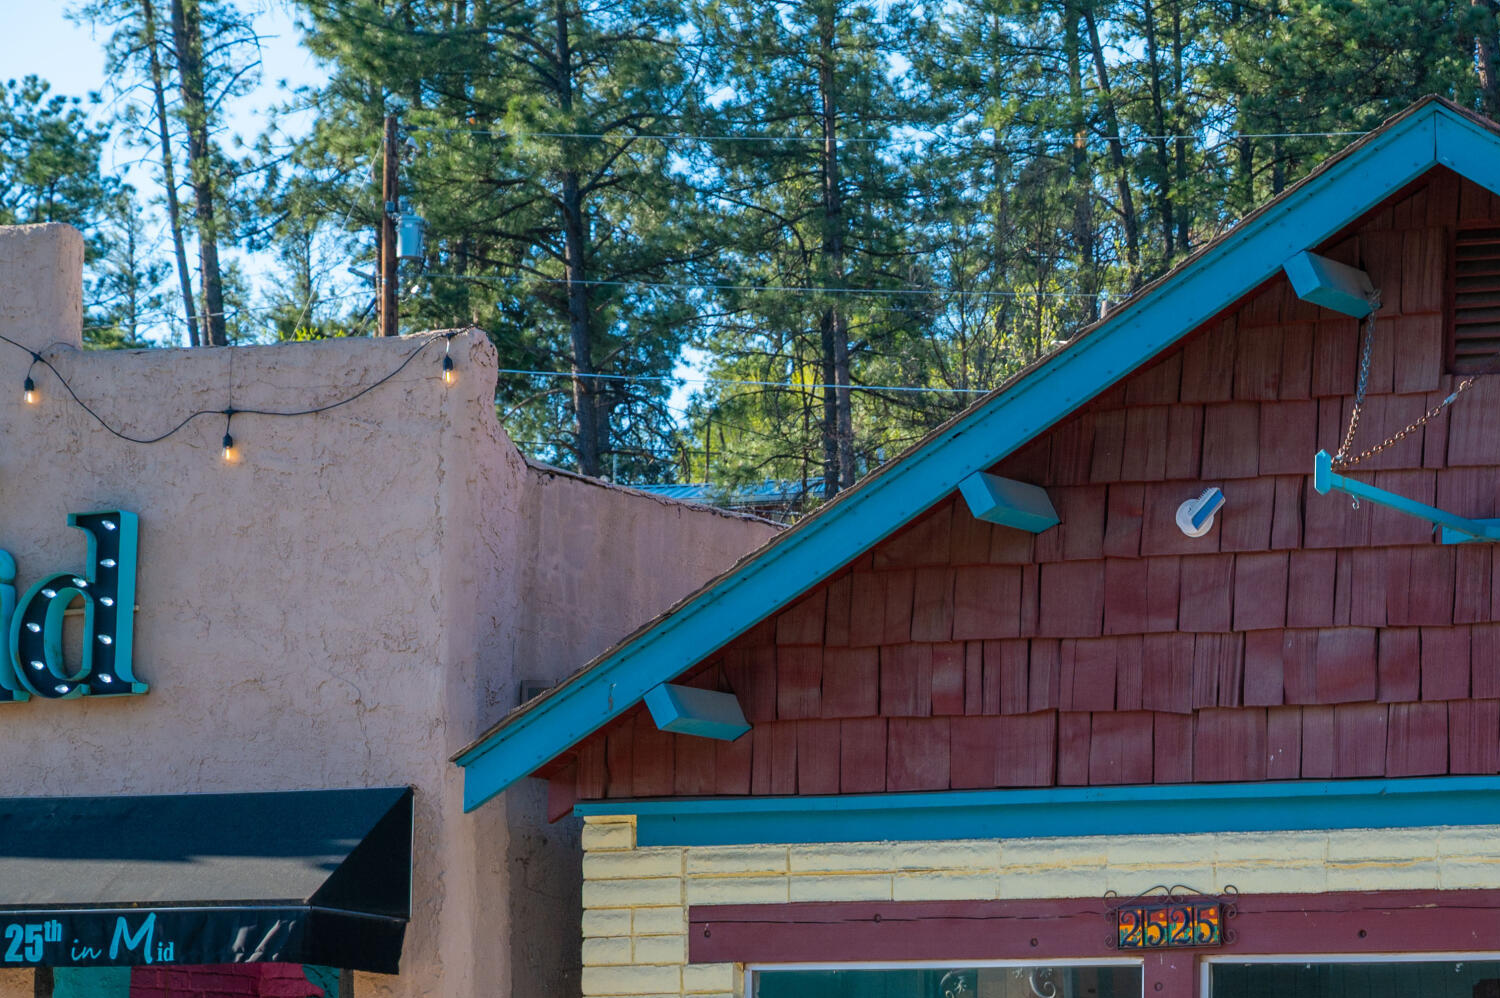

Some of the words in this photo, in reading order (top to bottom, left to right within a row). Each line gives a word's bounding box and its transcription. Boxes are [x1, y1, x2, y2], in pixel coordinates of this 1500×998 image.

[4, 919, 63, 962] 25th
[71, 939, 101, 961] in
[109, 912, 175, 964] Mid
[1119, 906, 1215, 947] 2525
